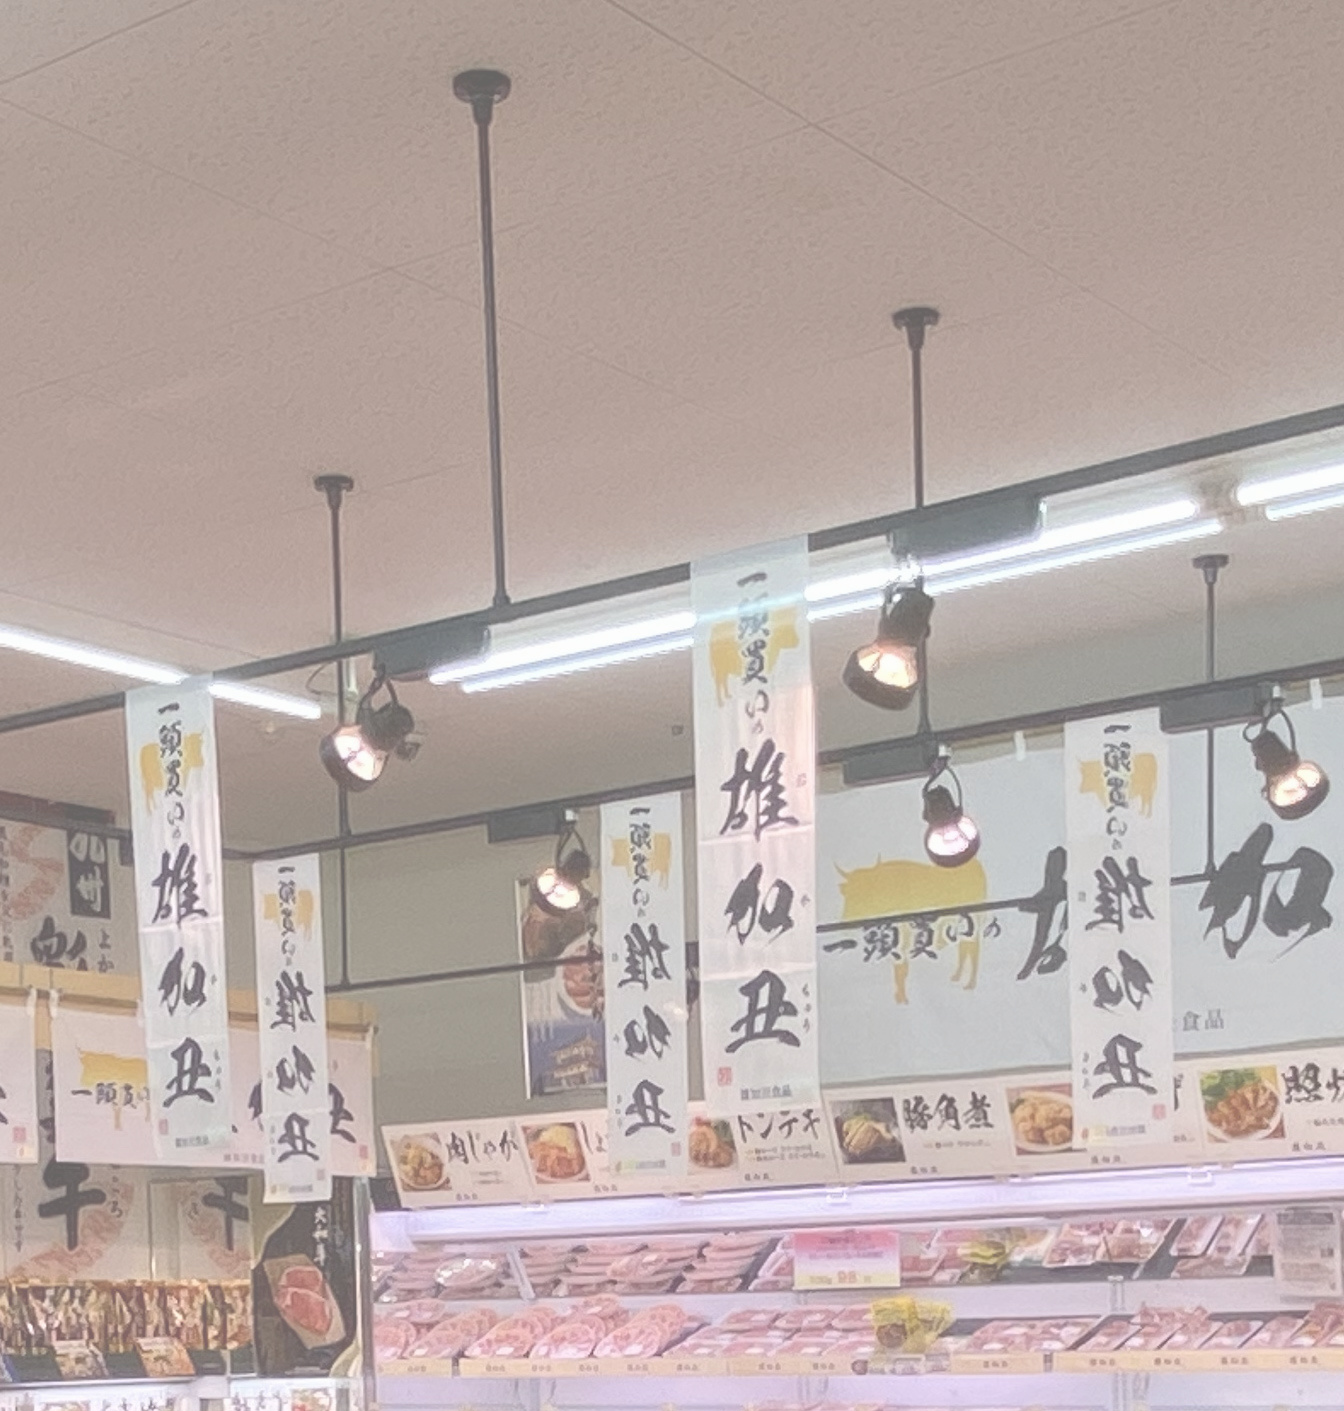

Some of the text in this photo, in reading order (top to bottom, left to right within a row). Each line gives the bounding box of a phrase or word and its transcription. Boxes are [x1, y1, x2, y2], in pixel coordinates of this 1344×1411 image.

[70, 1081, 151, 1110] 一頭買い
[901, 1089, 995, 1134] 豚角煮
[736, 1107, 821, 1144] トンテキ
